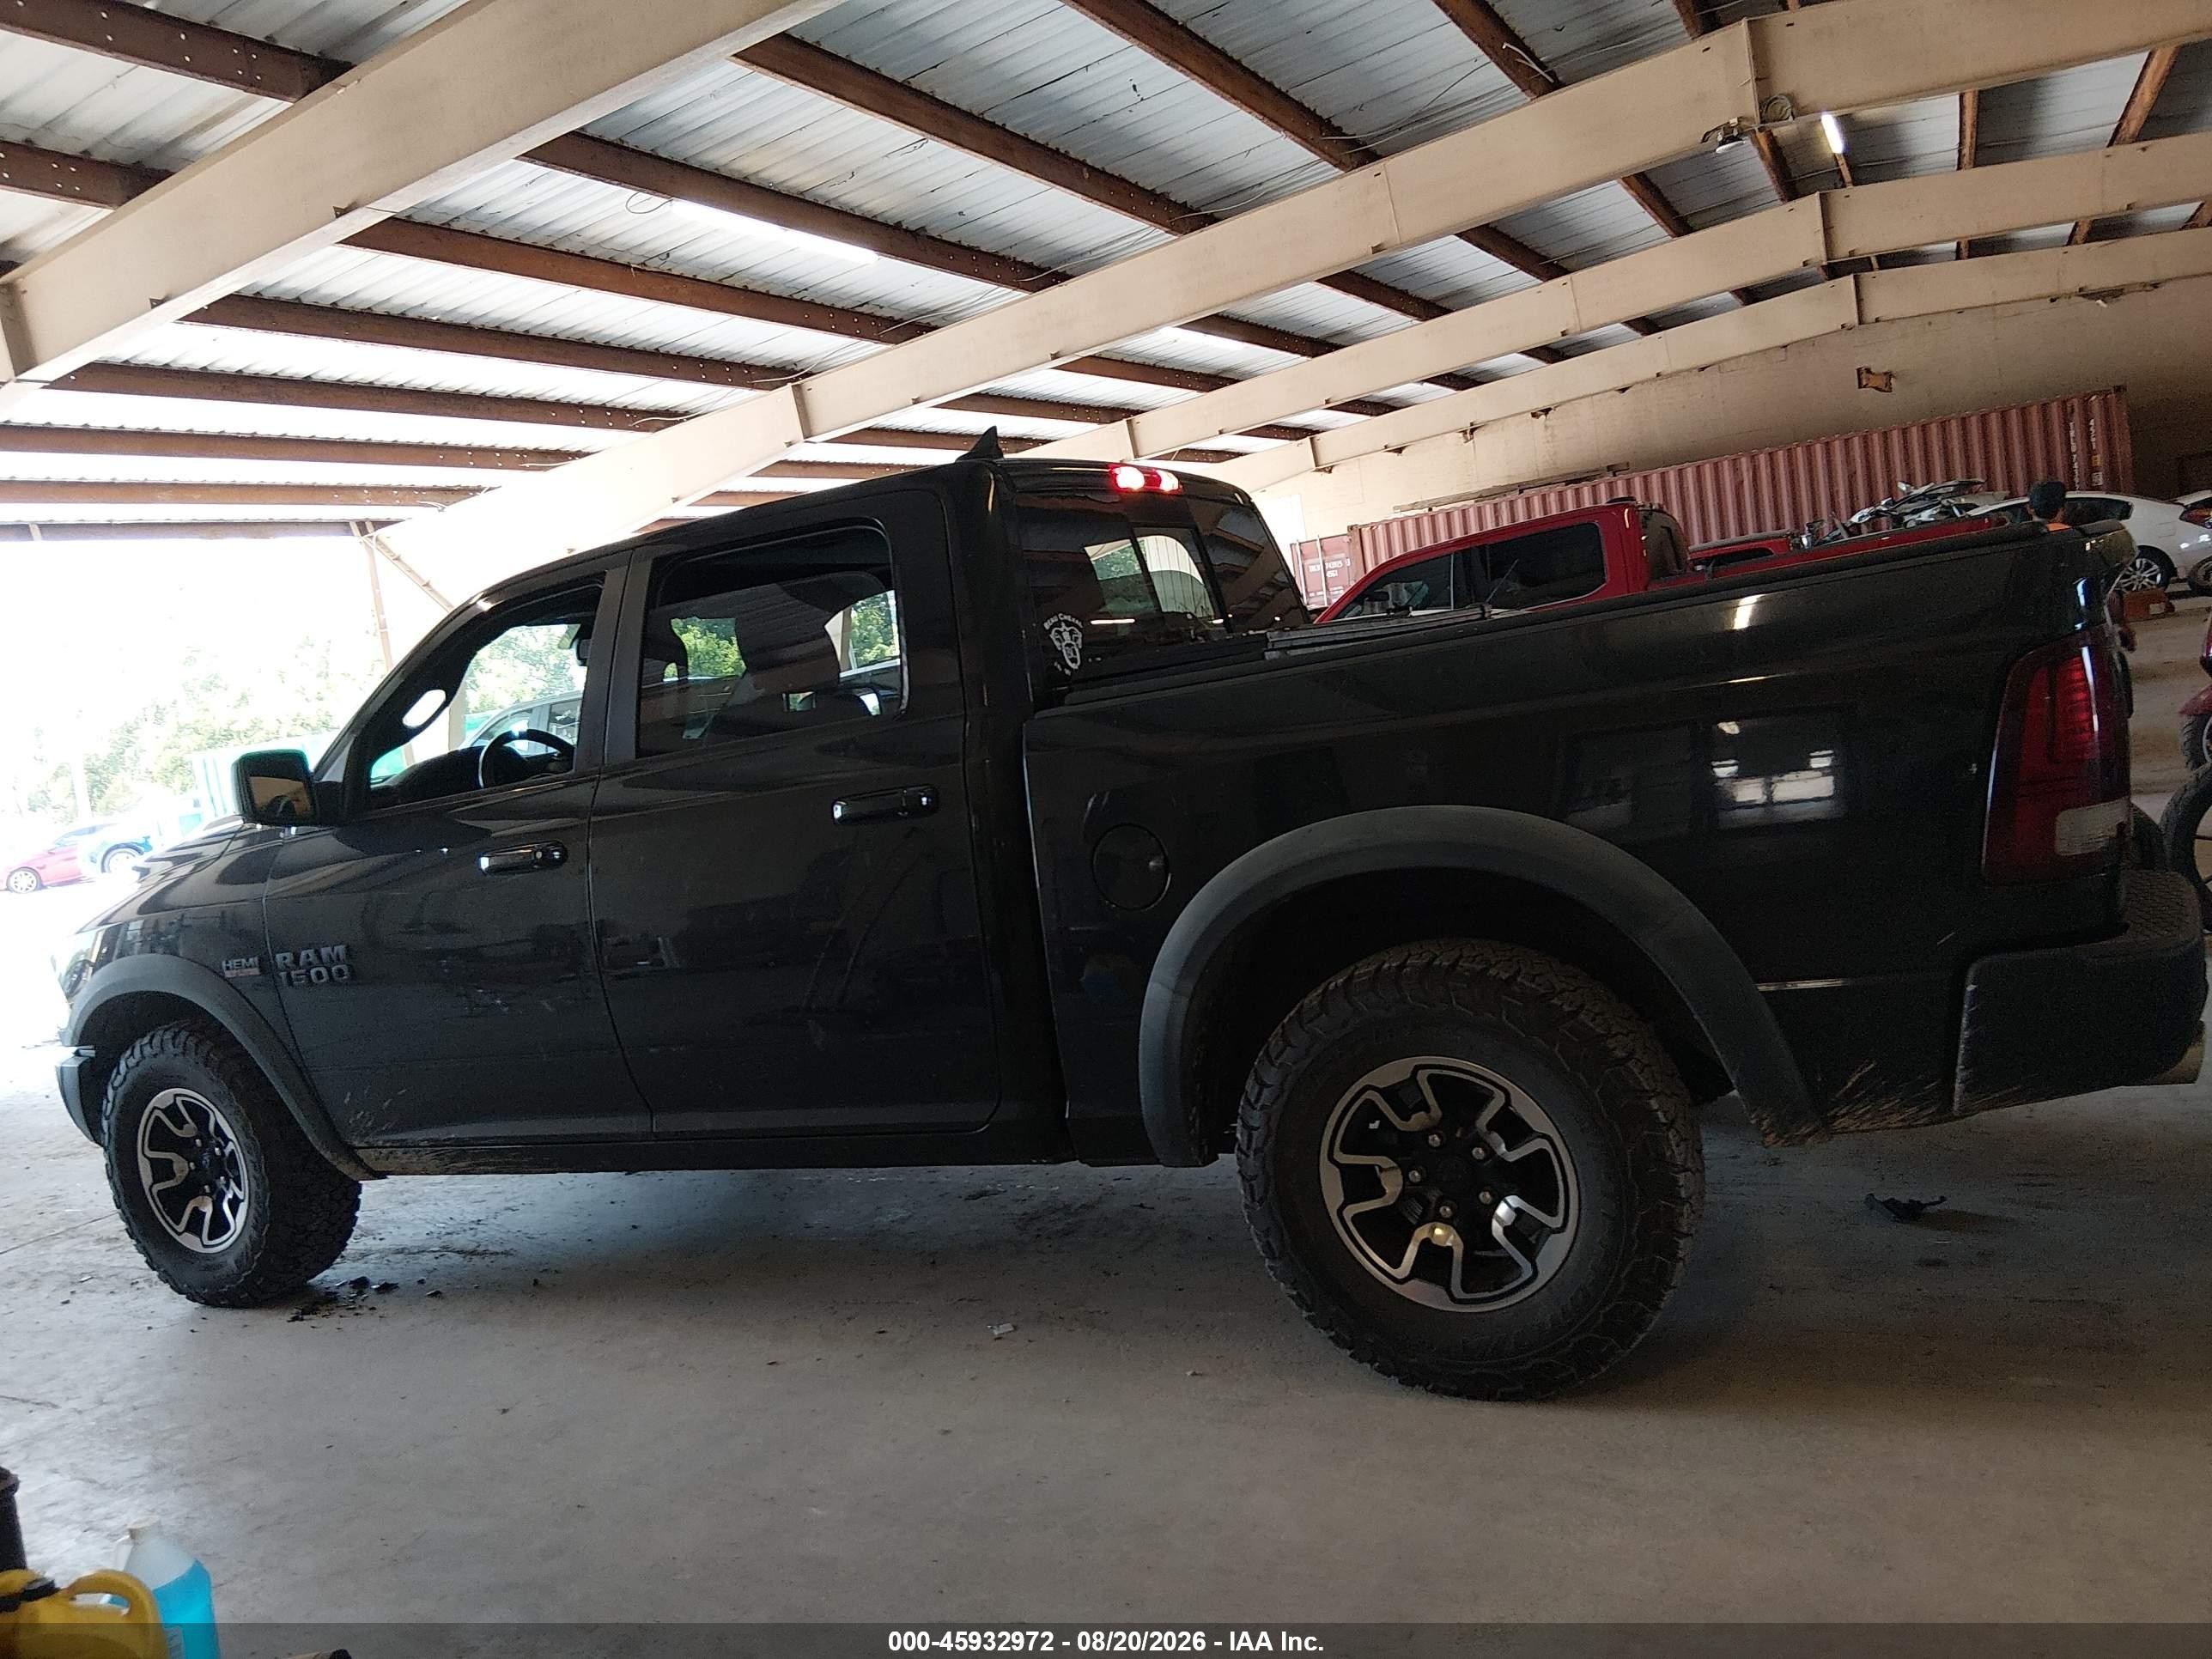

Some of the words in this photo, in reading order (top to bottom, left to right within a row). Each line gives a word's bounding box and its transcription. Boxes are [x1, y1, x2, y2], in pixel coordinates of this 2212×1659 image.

[222, 957, 258, 970] HEMI
[276, 945, 346, 969] RAM
[279, 964, 350, 987] 1500
